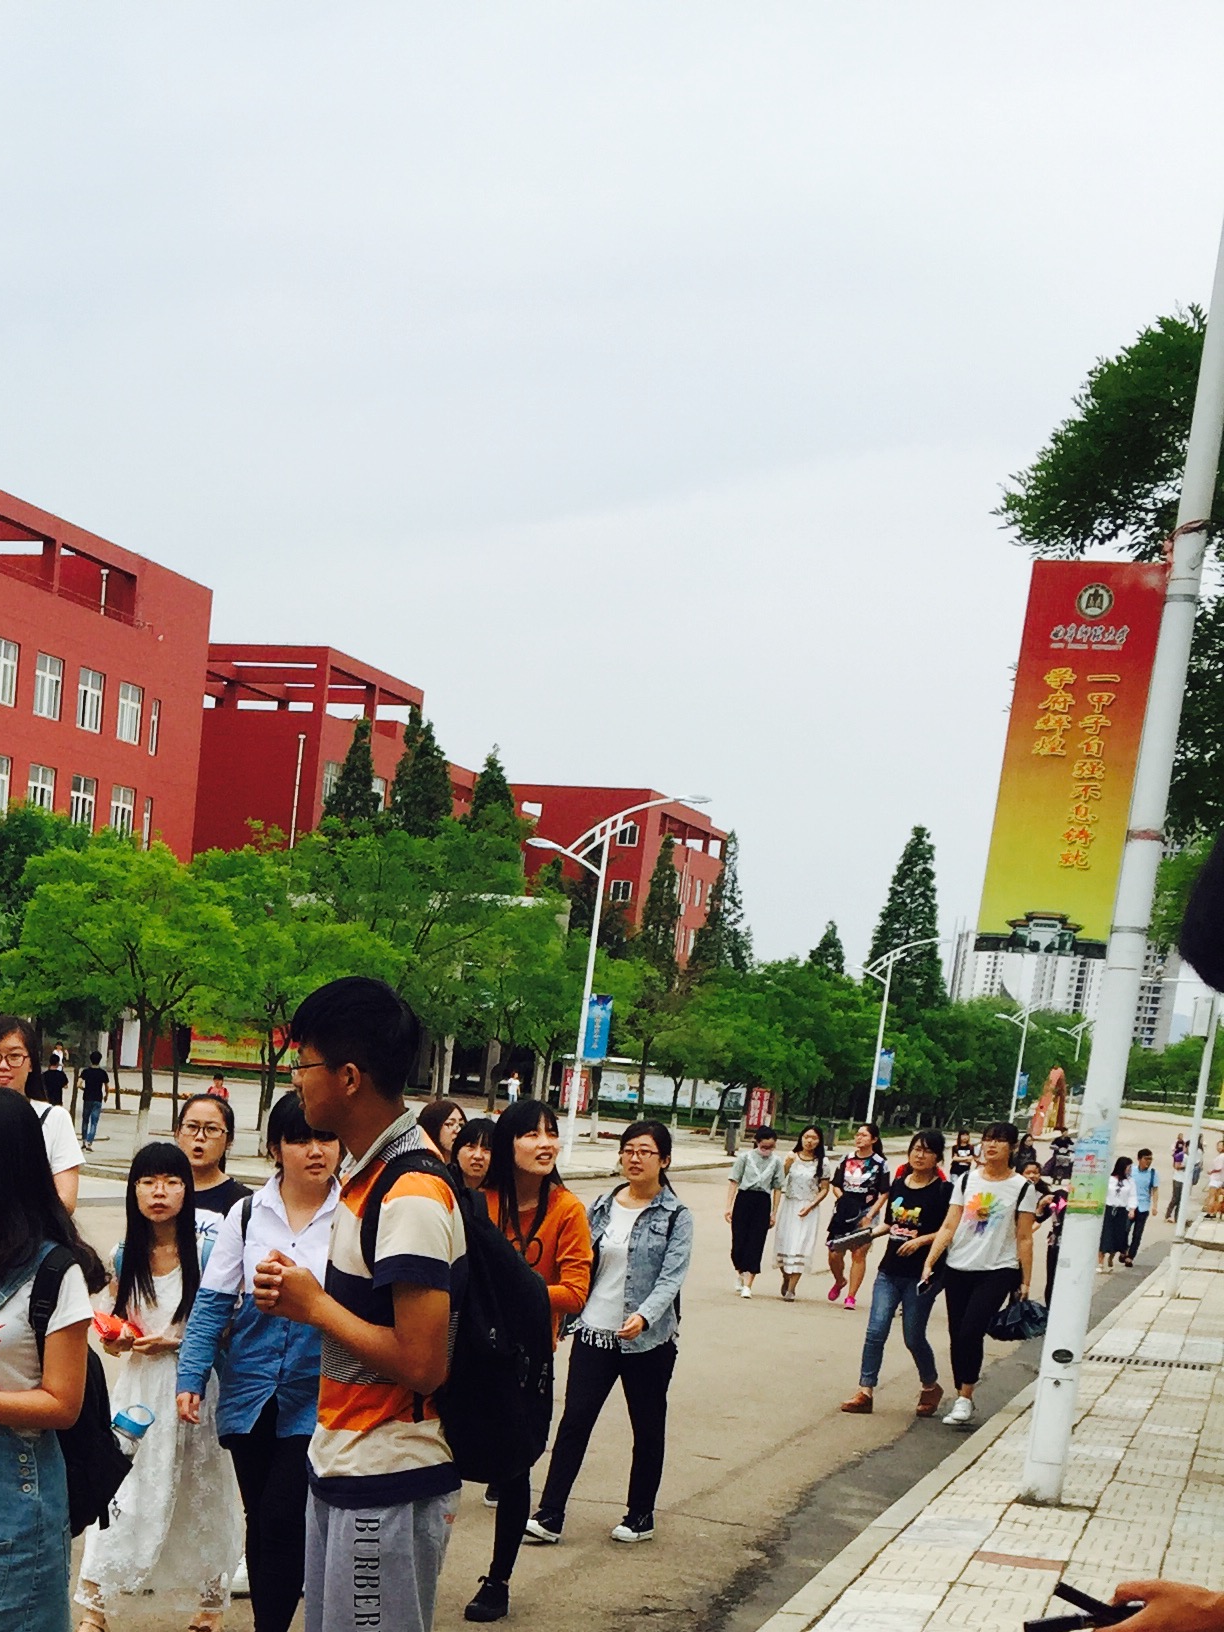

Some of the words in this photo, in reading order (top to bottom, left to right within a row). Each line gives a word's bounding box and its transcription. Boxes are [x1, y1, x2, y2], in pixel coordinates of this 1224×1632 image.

[1032, 667, 1077, 756] 学府辉煌
[1059, 673, 1121, 870] 一甲子自强不息铸就
